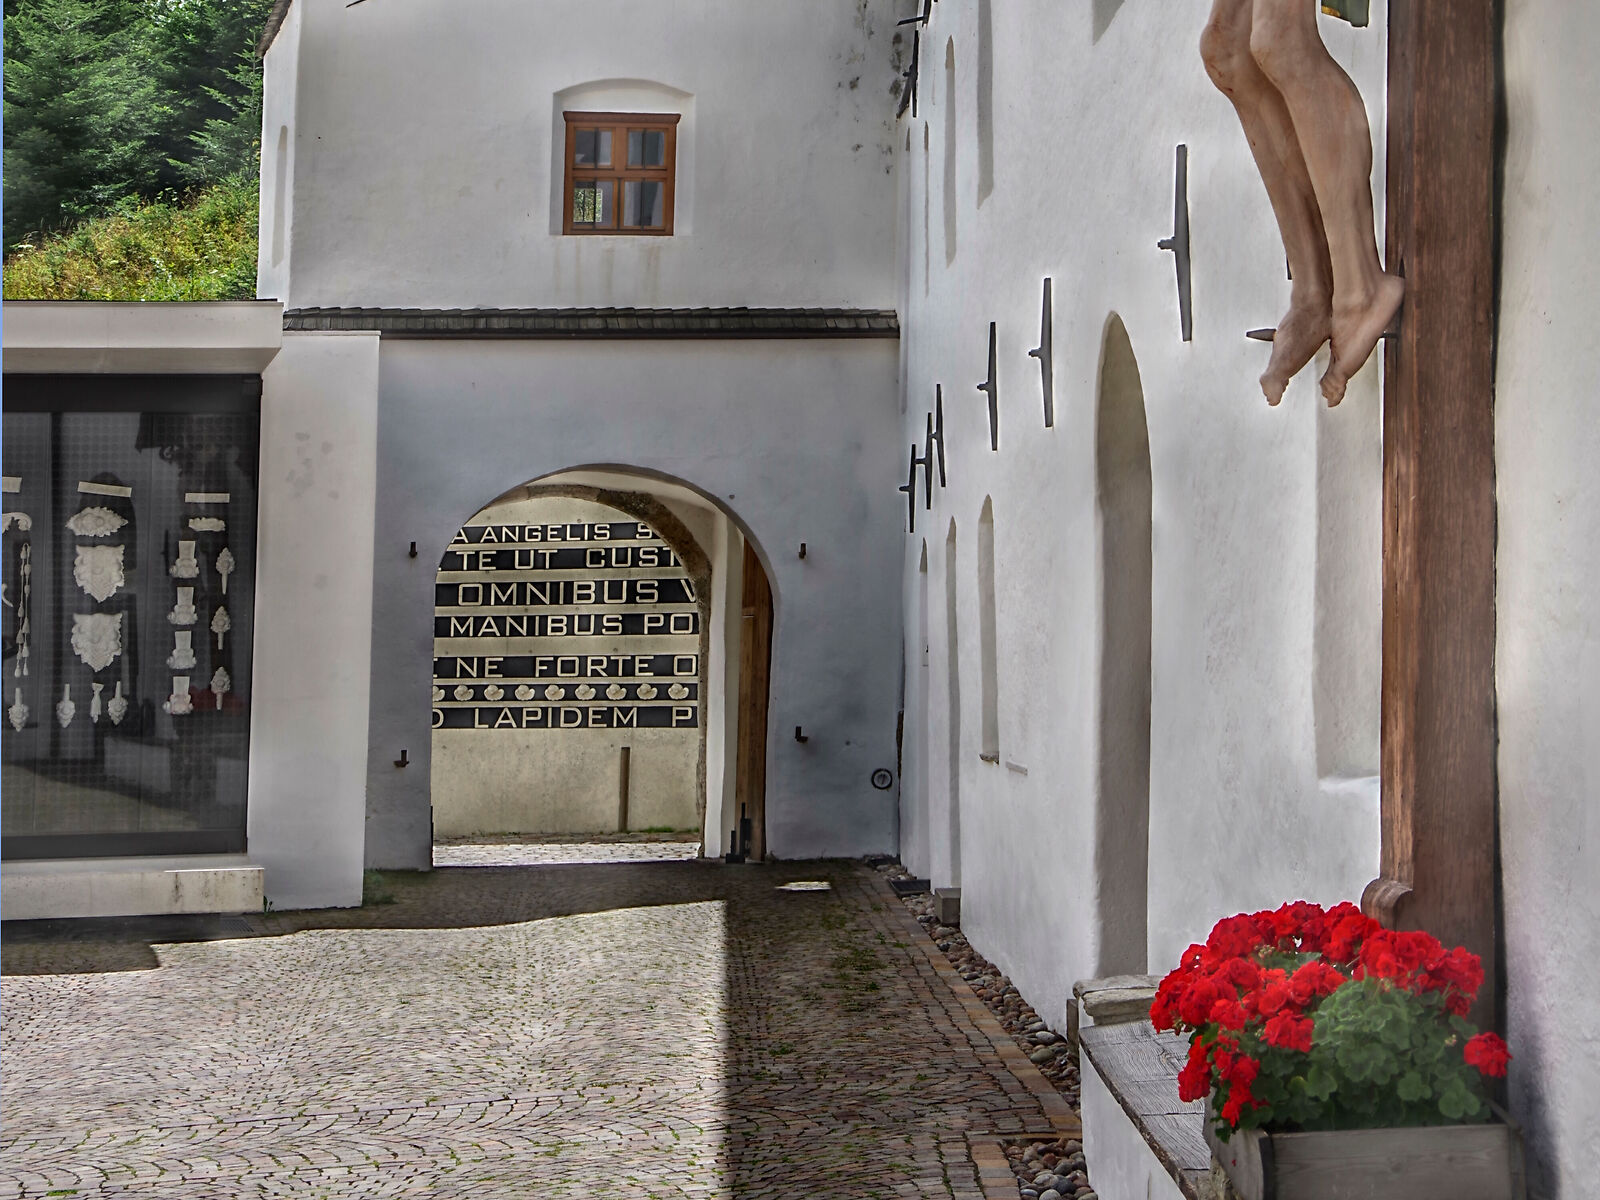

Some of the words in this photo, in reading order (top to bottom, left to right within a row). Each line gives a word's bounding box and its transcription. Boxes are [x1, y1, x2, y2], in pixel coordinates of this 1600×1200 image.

[480, 524, 610, 543] ANGELIS
[456, 550, 497, 571] TE
[514, 549, 558, 570] UT
[458, 579, 659, 606] OMNIBUS
[450, 613, 623, 637] MANIBUS
[643, 613, 693, 635] PO
[456, 657, 504, 678] NE
[535, 655, 654, 678] FORTE
[673, 655, 697, 676] O
[474, 707, 637, 729] LAPIDEM
[672, 706, 693, 727] P
